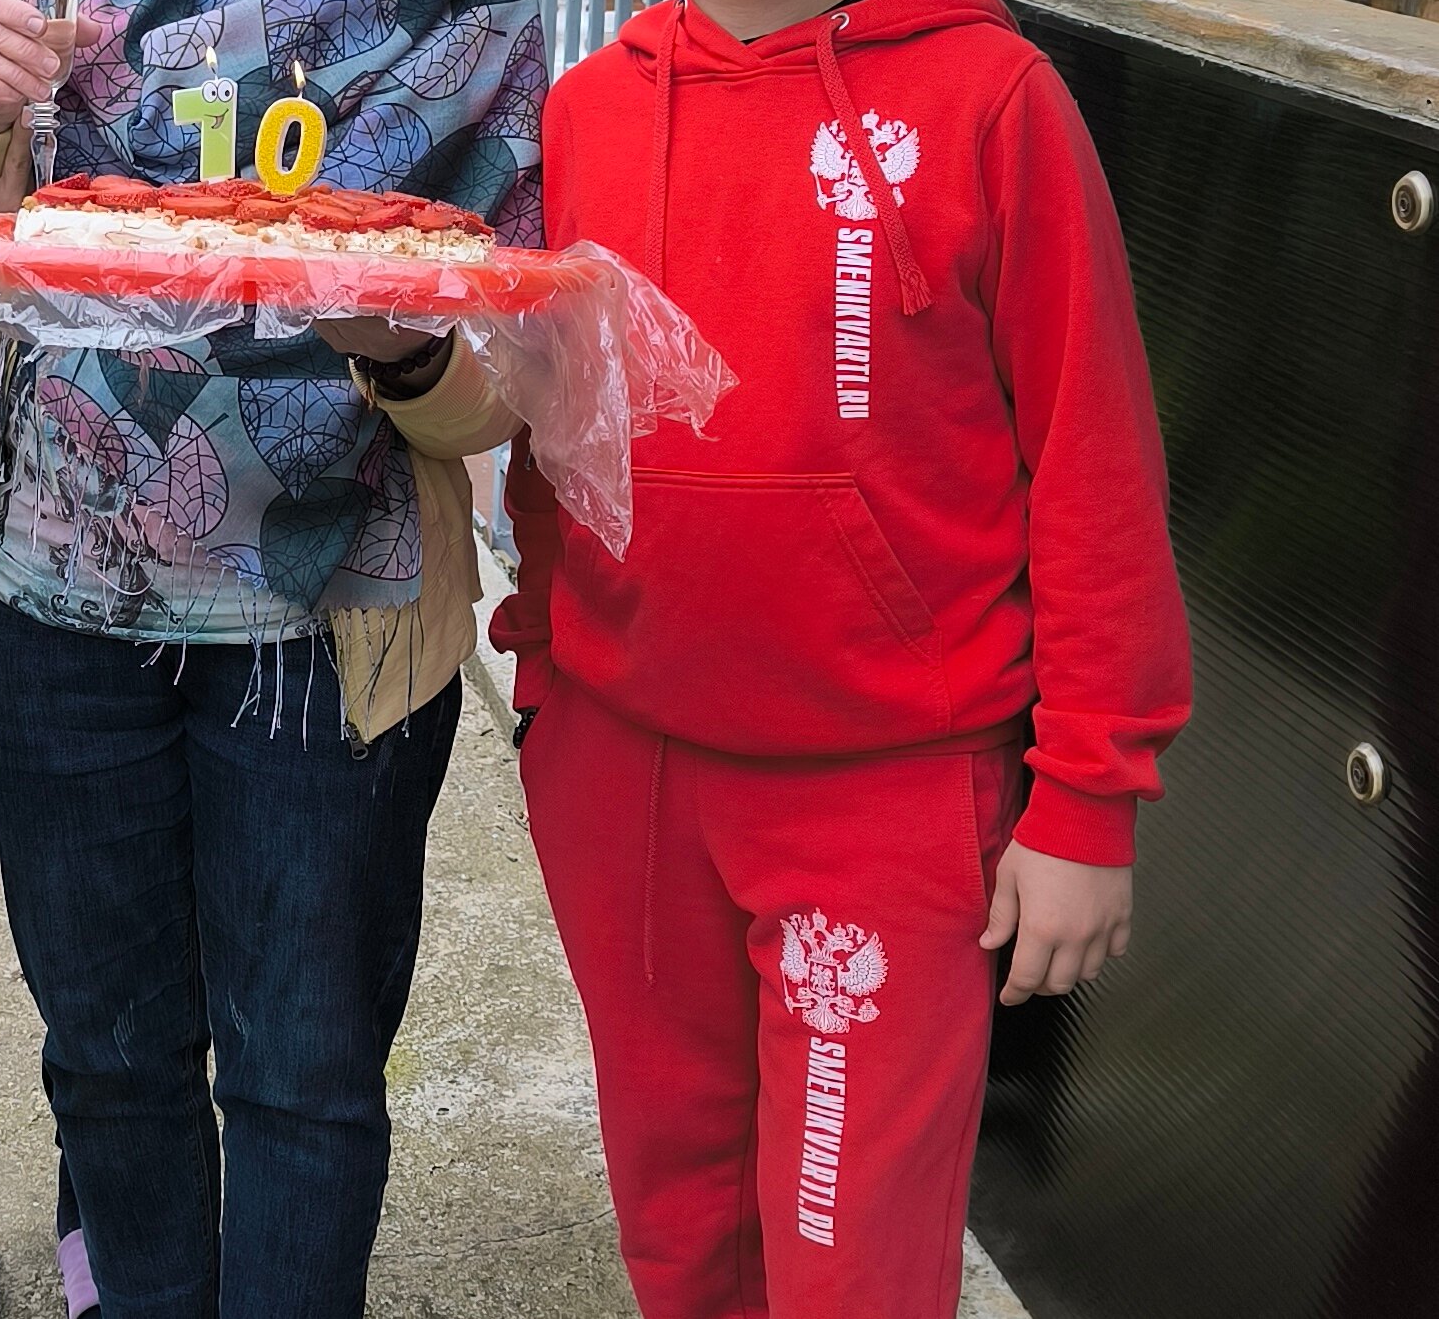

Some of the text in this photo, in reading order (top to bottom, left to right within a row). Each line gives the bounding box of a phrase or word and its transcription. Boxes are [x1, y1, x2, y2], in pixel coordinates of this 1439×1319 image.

[172, 78, 328, 197] 10
[834, 227, 874, 419] SMENIKVARTI.RU
[797, 1036, 847, 1247] SMENIKVARTI.RU
